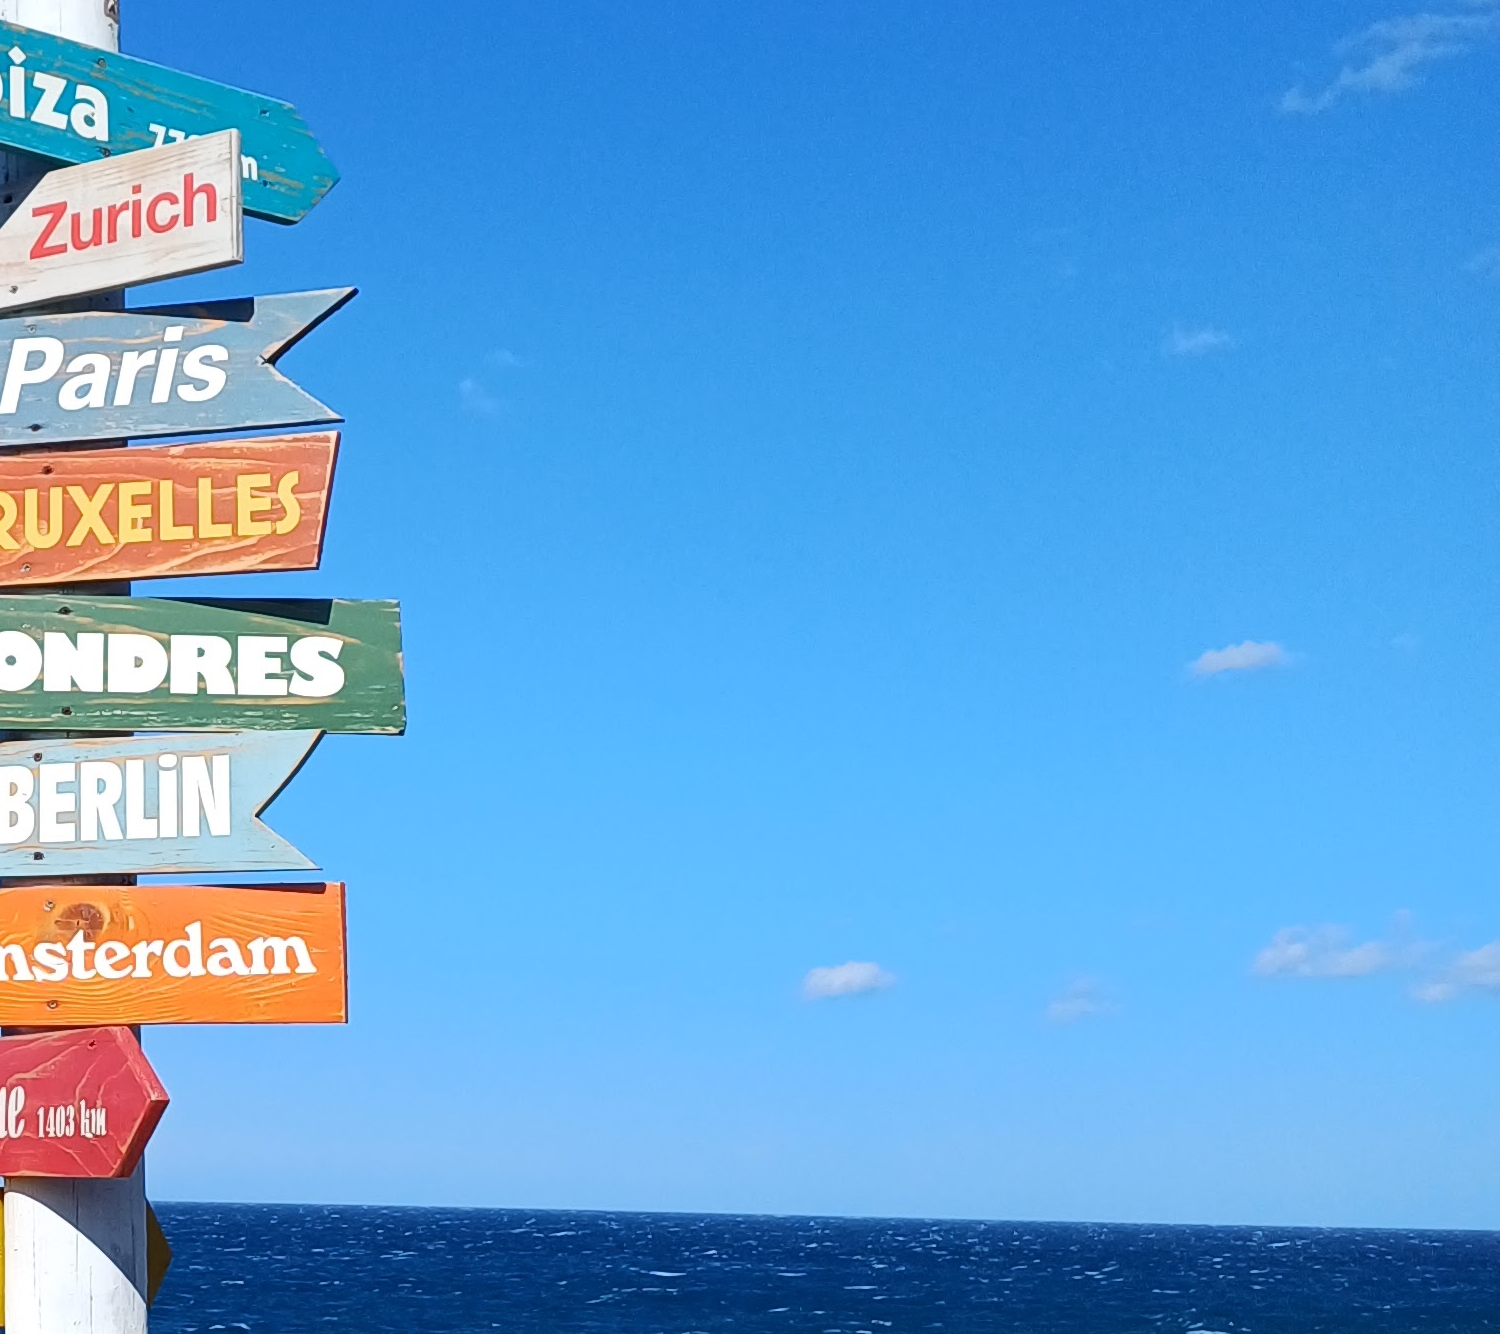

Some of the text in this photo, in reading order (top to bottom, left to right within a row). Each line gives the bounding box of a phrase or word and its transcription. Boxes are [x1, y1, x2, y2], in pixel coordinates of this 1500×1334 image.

[30, 173, 218, 261] Zurich
[36, 1104, 76, 1139] 1403
[79, 1098, 107, 1139] km
